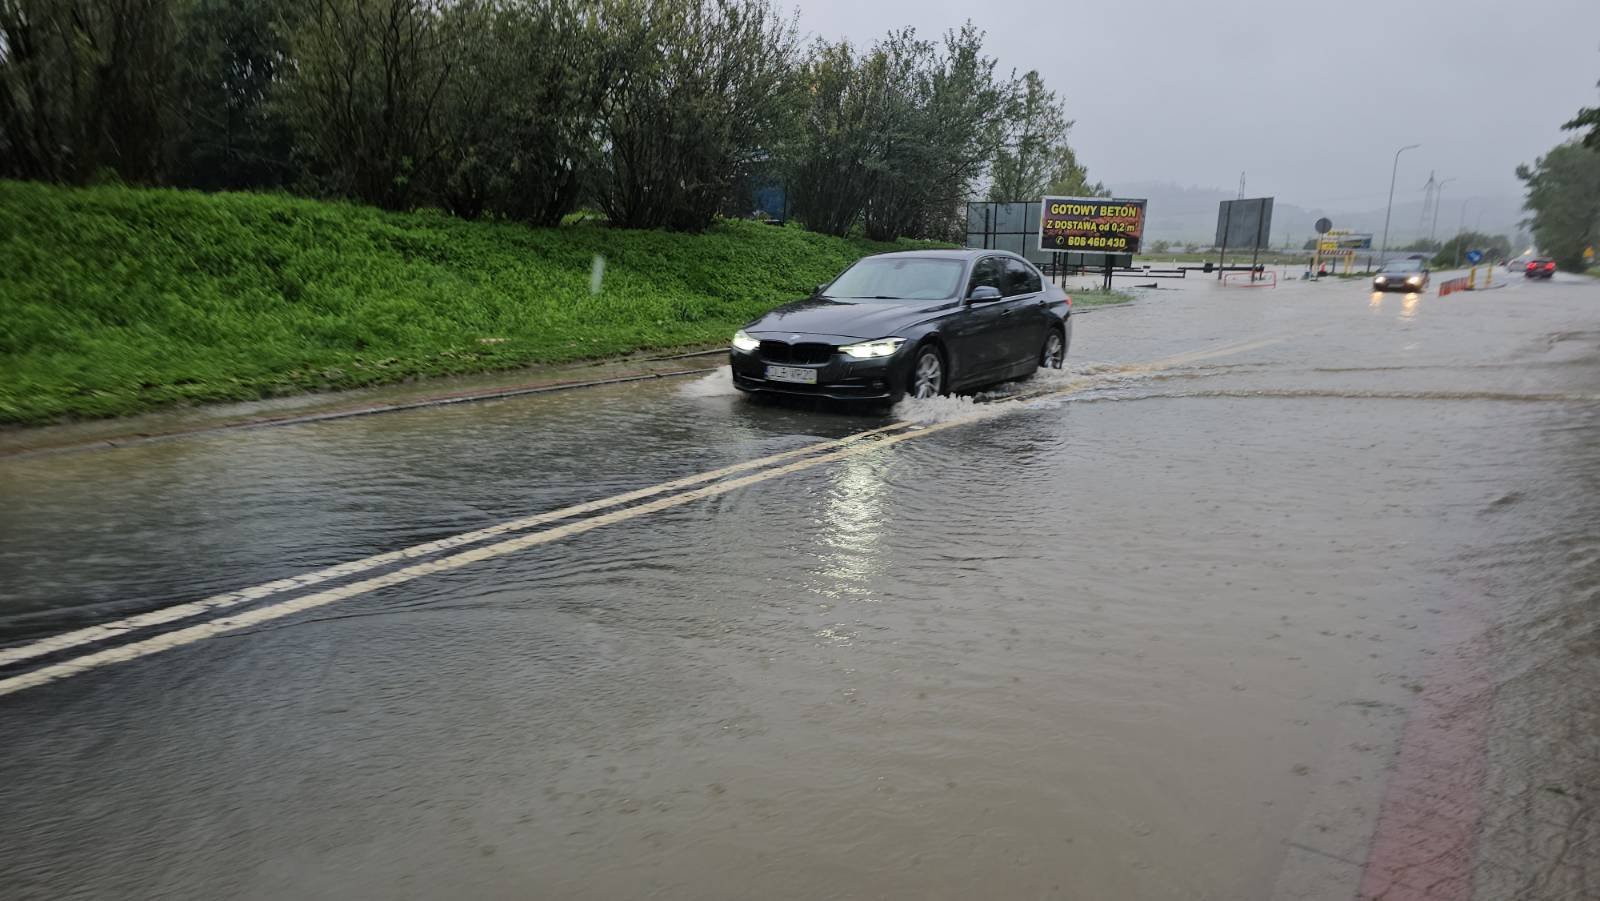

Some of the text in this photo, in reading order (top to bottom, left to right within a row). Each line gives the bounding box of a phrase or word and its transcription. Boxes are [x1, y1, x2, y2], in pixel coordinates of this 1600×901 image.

[1051, 204, 1137, 217] GOTOWY BETON
[1046, 220, 1053, 228] Z
[1098, 223, 1109, 231] od
[1111, 223, 1125, 232] 0,2
[1068, 236, 1126, 248] 606 460 430
